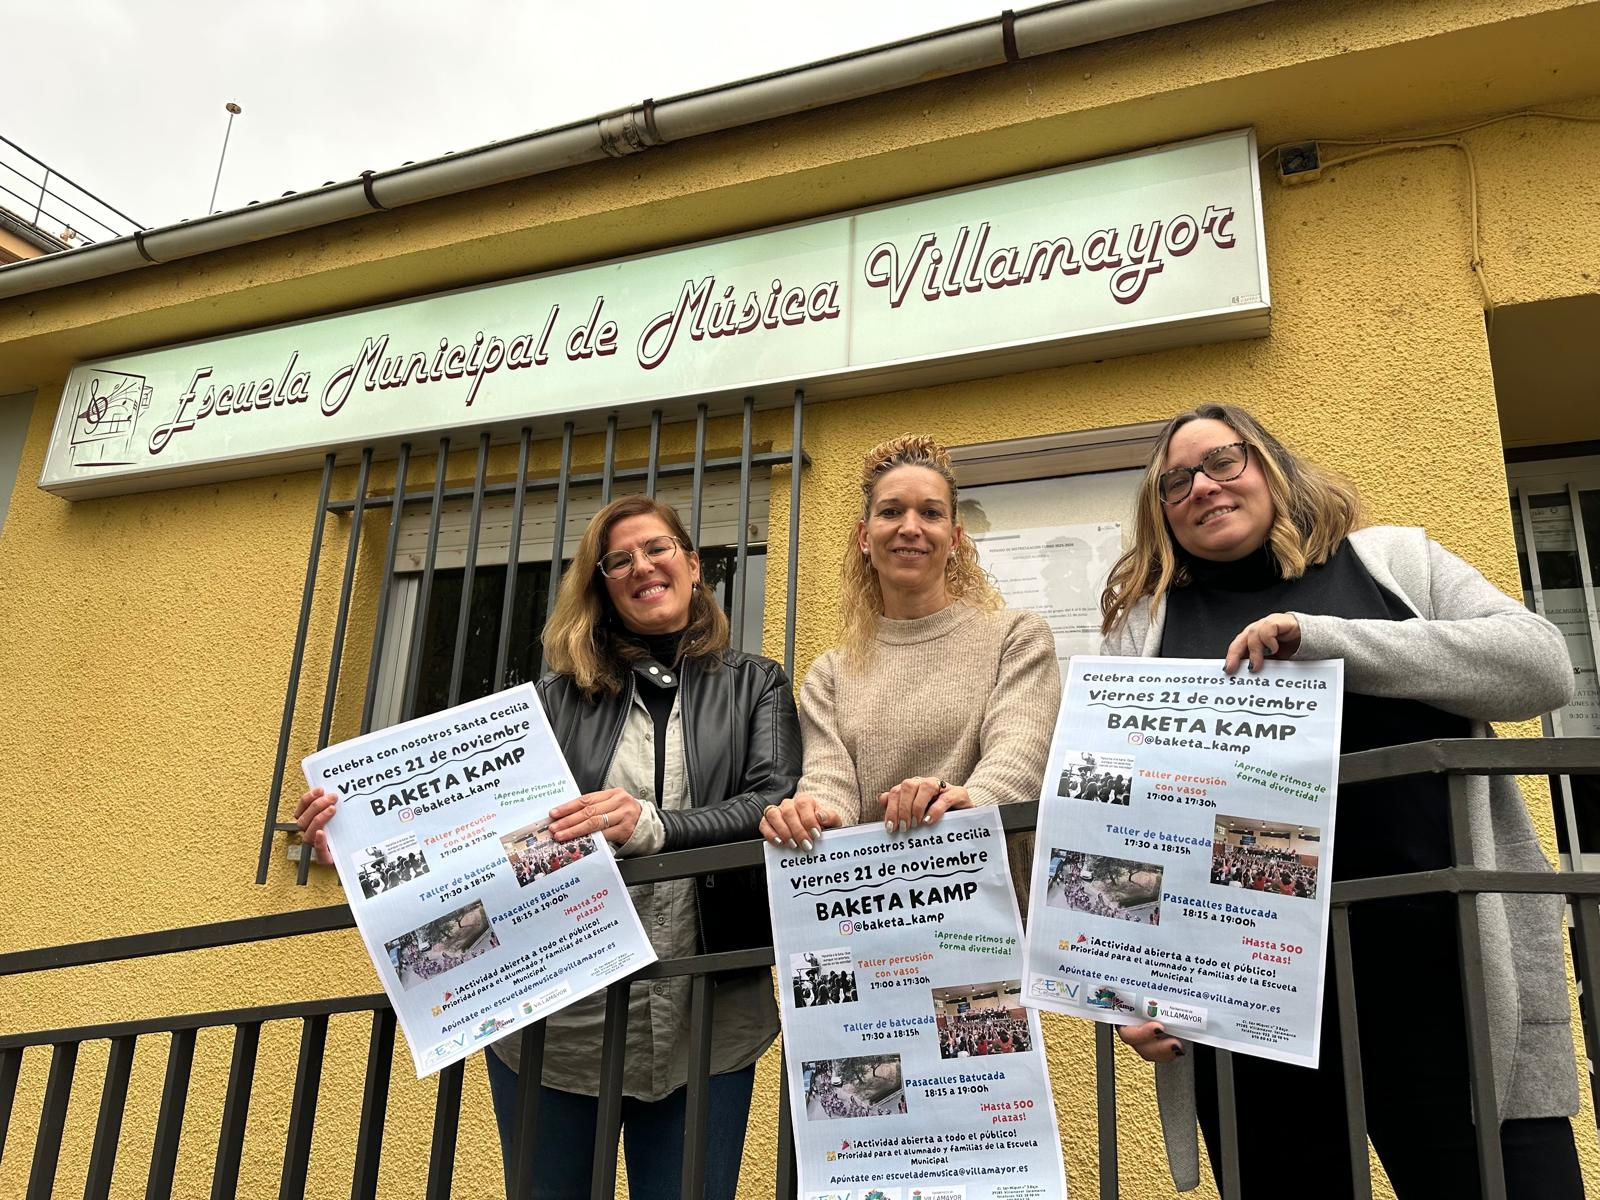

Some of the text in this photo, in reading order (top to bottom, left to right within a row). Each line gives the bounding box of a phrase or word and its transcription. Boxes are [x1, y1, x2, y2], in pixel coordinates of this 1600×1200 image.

[148, 205, 1236, 455] Escuela Municipal de Música Villamayor
[1083, 673, 1327, 690] Celebra con nosotros Santa Cecilia
[1089, 690, 1318, 712] Viernes 21 de noviembre
[1107, 713, 1296, 741] BAKETA KAMP
[323, 702, 529, 779] Celebra con nosotros Santa Cecilia
[1144, 735, 1251, 755] @baketa_kamp
[337, 720, 530, 795] Viernes 21 de noviembre
[370, 746, 526, 816] BAKETA KAMP
[531, 782, 556, 793] ritmos
[1139, 769, 1227, 786] Taller percusión
[1236, 772, 1319, 802] forma divertida!
[1279, 775, 1313, 789] ritmos
[1314, 784, 1327, 794] de
[413, 778, 501, 815] @baketa_kamp
[526, 787, 565, 801] divertida!
[1155, 783, 1207, 796] con vasos
[1147, 792, 1217, 808] 17:00 17:30h
[423, 830, 453, 846] Taller
[455, 812, 497, 834] percusión
[443, 827, 486, 849] con vasos
[1106, 824, 1212, 848] Taller de batucada
[440, 830, 497, 859] 17:00 17:30h
[780, 827, 991, 869] Celebra con nosotros Santa Cecilia
[1124, 838, 1191, 855] 17:30 18:15h
[419, 857, 508, 902] Taller de batucada
[790, 850, 988, 890] Viernes 21 de noviembre
[440, 872, 496, 903] 17:30 18:15h
[591, 888, 609, 903] 500
[491, 875, 581, 925] Pasacalles Batucada
[512, 893, 569, 925] 18:15 19:00h
[816, 882, 978, 921] BAKETA KAMP
[1163, 892, 1278, 920] Pasacalles Batucada
[576, 902, 605, 922] plazas!
[854, 912, 945, 932] @baketa_kamp
[1182, 908, 1256, 928] 18:15 19:00h
[500, 954, 531, 974] abierta
[539, 940, 557, 953] todo
[569, 918, 601, 940] público!
[939, 942, 1011, 955] forma divertida!
[975, 934, 1004, 944] ritmos
[1280, 943, 1304, 955] 500
[442, 919, 619, 1011] Prioridad para alumnado familias Escuela
[858, 959, 887, 969] Taller
[889, 951, 934, 967] percusión
[1144, 947, 1182, 961] abierta
[1194, 955, 1218, 967] todo
[1233, 962, 1277, 978] público!
[1252, 951, 1292, 965] plazas!
[512, 965, 547, 986] Municipal
[875, 966, 920, 978] con vasos
[1070, 944, 1298, 993] Prioridad para alumnado familias Escuela
[1151, 969, 1194, 984] Municipal
[441, 1011, 479, 1034] Apúntate
[480, 1005, 492, 1014] en:
[493, 941, 616, 1008] escuelademusica@villamayor.es
[870, 976, 931, 990] 17:00 17:30h
[1058, 964, 1102, 980] Apúntate
[1104, 974, 1119, 982] en:
[1120, 977, 1281, 1014] escuelademusica@villamayor.es
[843, 1015, 935, 1033] Taller de batucada
[1160, 1009, 1202, 1023] VILLAMAYOR
[861, 1029, 920, 1041] 17:30 18:15h
[905, 1071, 1006, 1088] Pasacalles Batucada
[924, 1085, 989, 1098] 18:15 19:00h
[1013, 1100, 1034, 1109] 500
[992, 1112, 1026, 1124] plazas!
[901, 1135, 935, 1145] abierta
[945, 1133, 966, 1142] todo
[980, 1129, 1017, 1141] público!
[837, 1140, 1038, 1160] Prioridad para alumnado familias Escuela
[911, 1156, 949, 1165] Municipal
[830, 1165, 1028, 1184] Apúntate en: escuelademusica@villamayor.es
